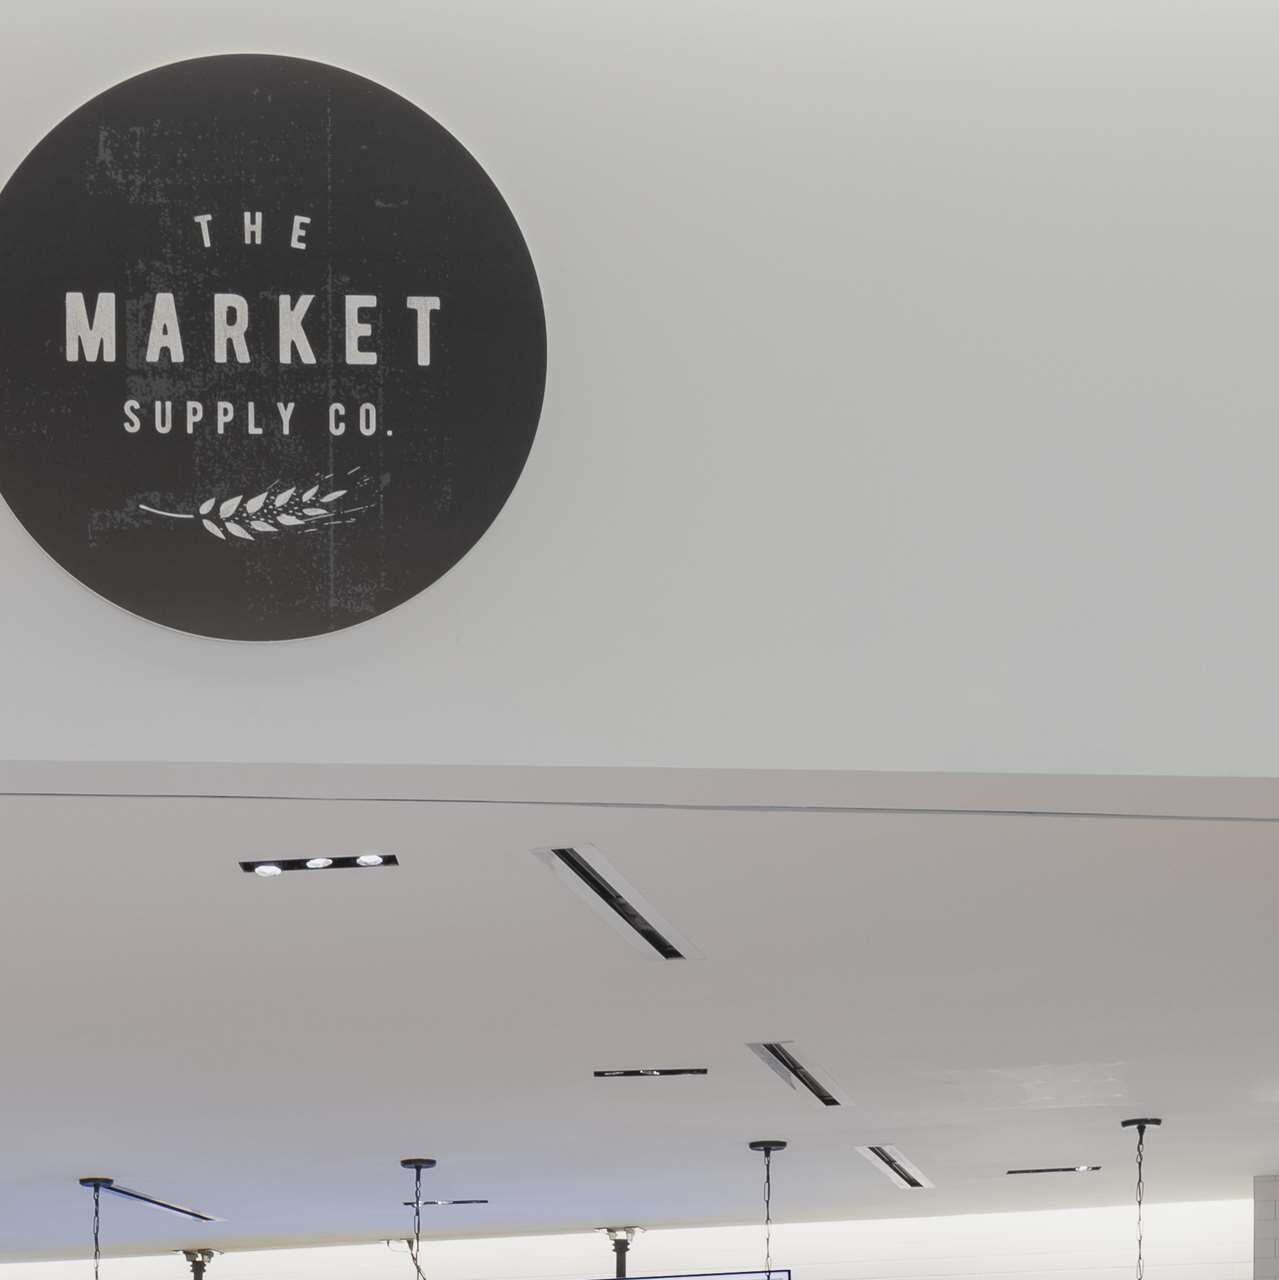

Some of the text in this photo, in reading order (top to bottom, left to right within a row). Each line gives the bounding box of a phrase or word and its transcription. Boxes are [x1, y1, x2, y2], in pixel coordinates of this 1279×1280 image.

[194, 211, 311, 250] THE
[65, 292, 440, 366] MARKET
[123, 400, 393, 436] SUPPLY CO.
